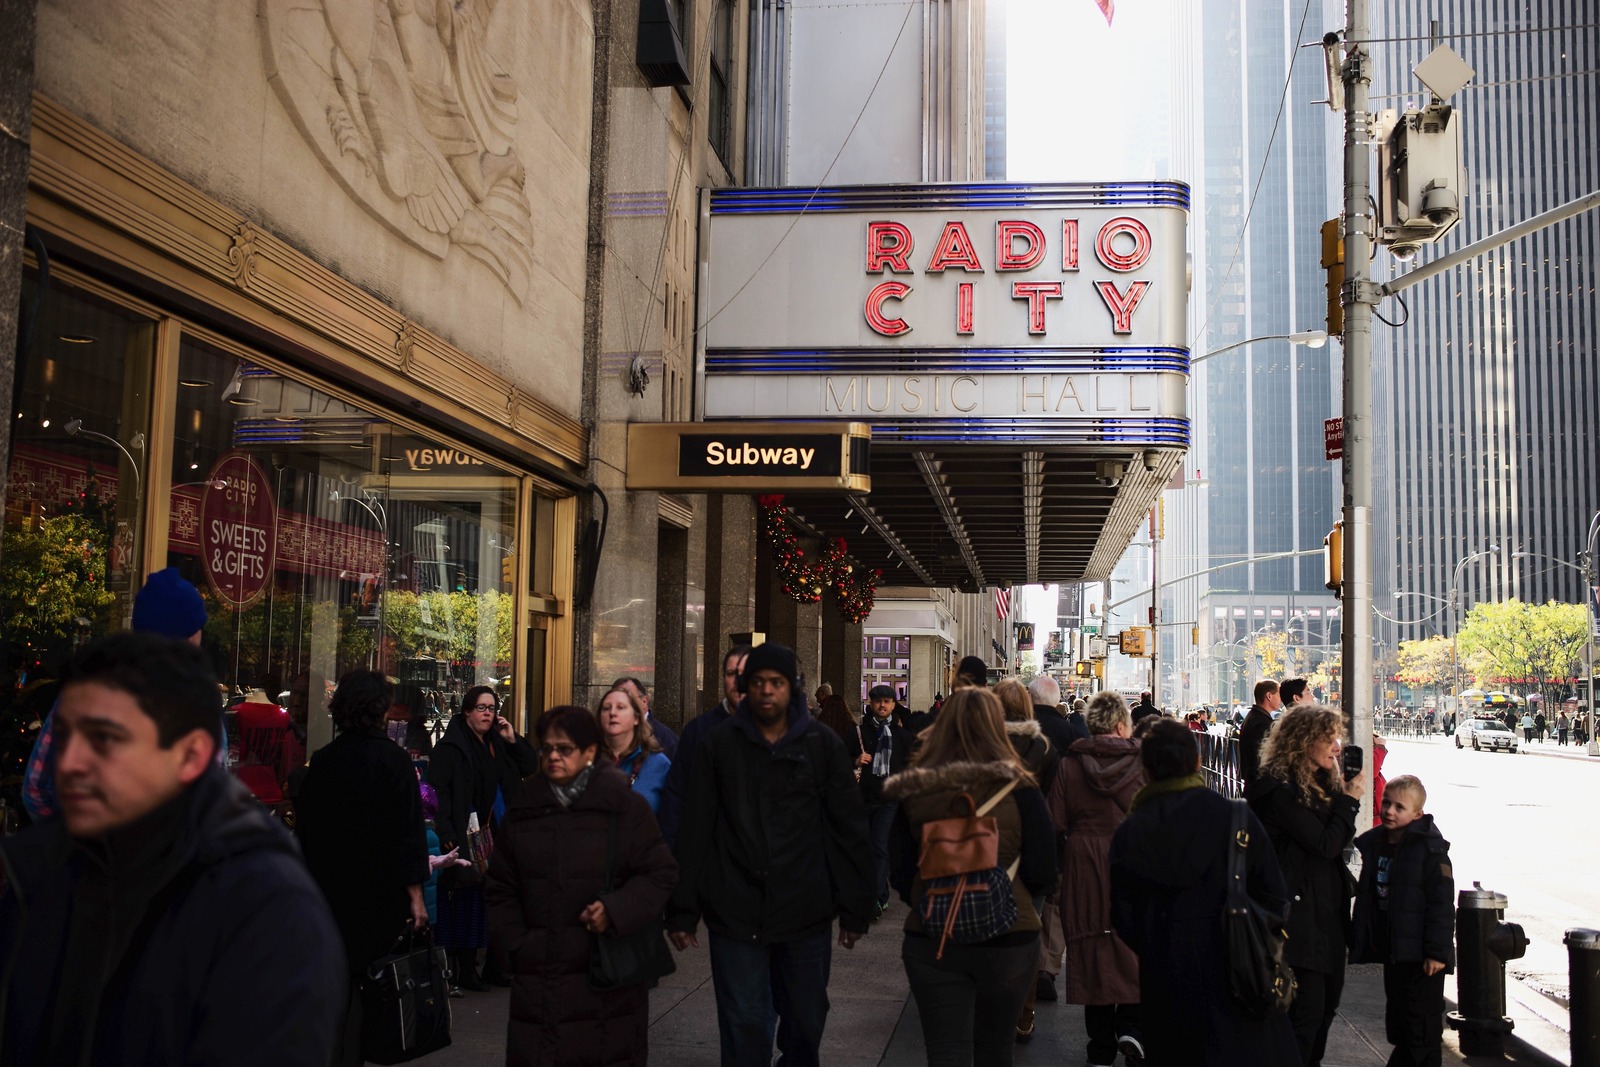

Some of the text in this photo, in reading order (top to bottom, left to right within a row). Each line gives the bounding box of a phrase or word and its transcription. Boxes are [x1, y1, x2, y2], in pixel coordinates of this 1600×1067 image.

[866, 216, 1152, 274] RADIO
[864, 280, 1152, 336] CITY
[825, 376, 1151, 412] MUSIC HALL
[1326, 422, 1334, 431] NO
[706, 442, 815, 469] Subway
[226, 475, 257, 494] RADIO
[226, 490, 257, 507] CITY
[211, 519, 267, 553] SWEETS
[212, 547, 264, 579] & GIFTS
